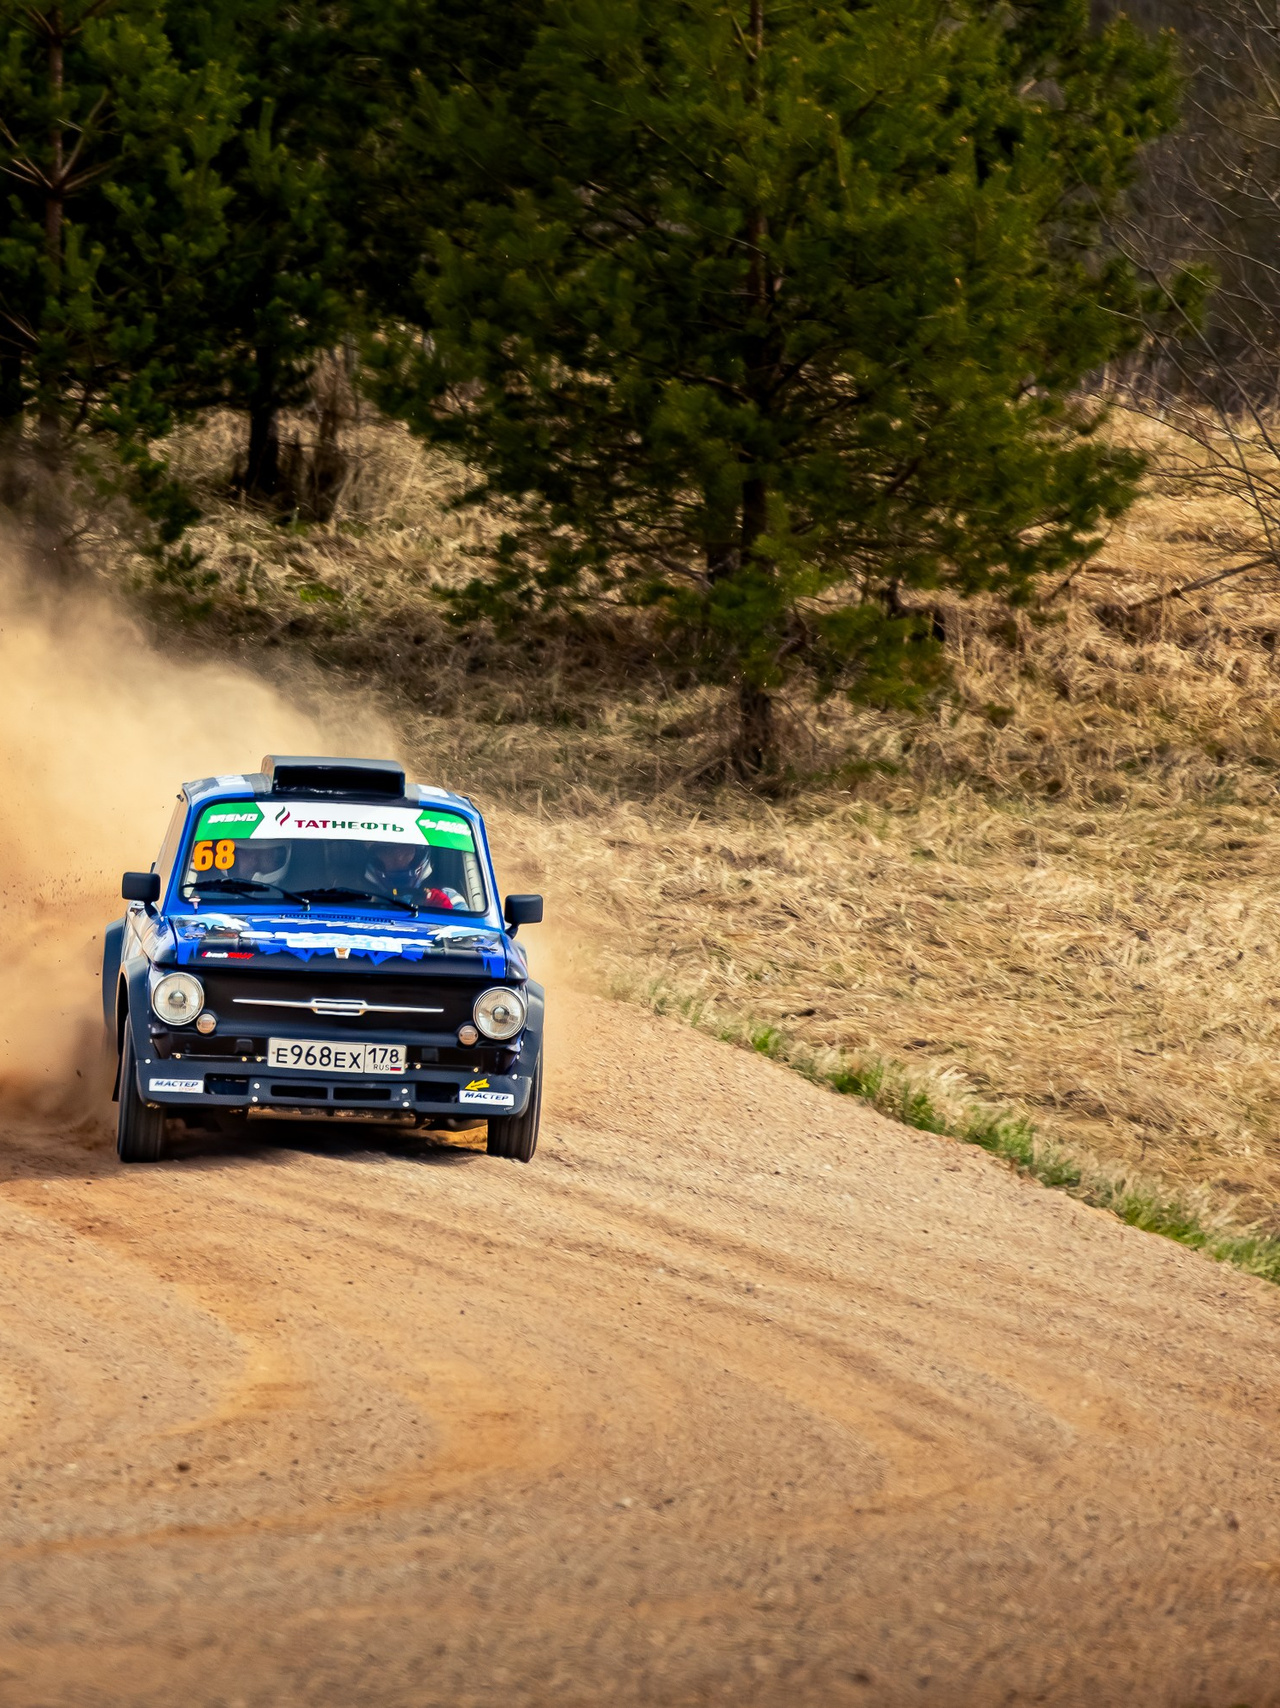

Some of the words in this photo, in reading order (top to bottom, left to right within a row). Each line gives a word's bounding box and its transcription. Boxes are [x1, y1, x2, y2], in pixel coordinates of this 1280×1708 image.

[294, 819, 405, 833] ТАТНЕФТЬ
[193, 839, 235, 871] 68
[367, 1047, 400, 1064] 178
[154, 1080, 199, 1088] МАСТЕР
[464, 1092, 509, 1101] МАСТЕР
